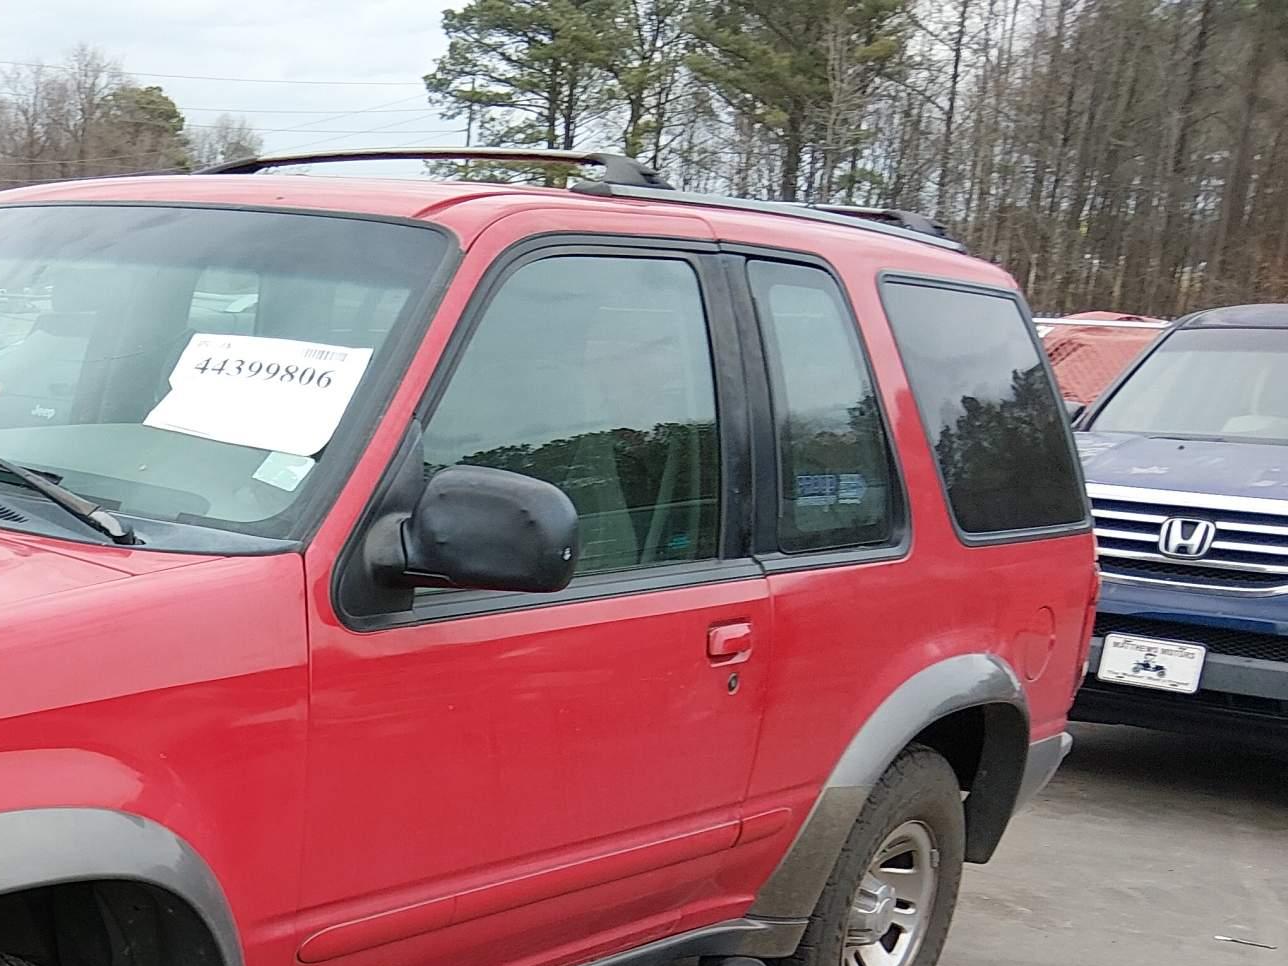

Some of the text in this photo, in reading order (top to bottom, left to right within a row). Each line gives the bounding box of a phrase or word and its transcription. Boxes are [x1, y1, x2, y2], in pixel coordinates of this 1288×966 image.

[194, 357, 334, 388] 44399806
[31, 404, 56, 420] Jeep
[1160, 648, 1196, 660] MOTORS
